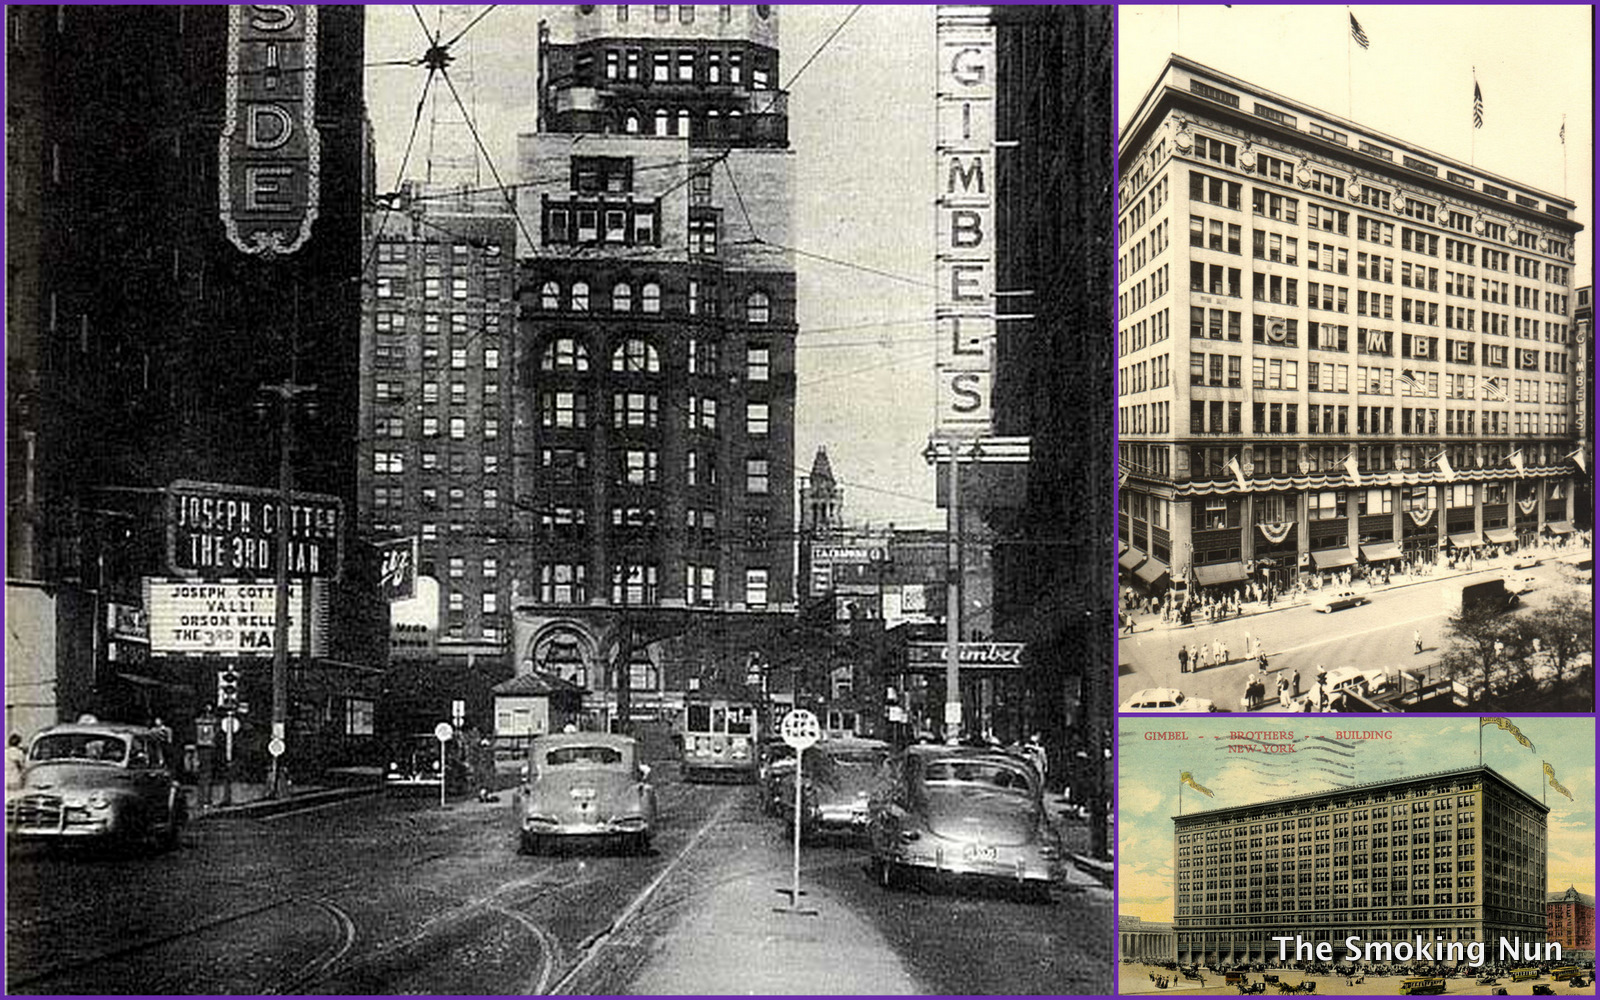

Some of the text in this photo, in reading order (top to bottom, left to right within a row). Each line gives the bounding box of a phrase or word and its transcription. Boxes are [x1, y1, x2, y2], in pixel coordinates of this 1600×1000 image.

[947, 47, 986, 414] GIMBELS
[1265, 317, 1536, 368] GIMBELS
[1575, 332, 1586, 431] GIMBELS
[178, 496, 251, 533] JOSEPH
[190, 533, 319, 573] THE 3RD AN
[171, 587, 294, 599] JOSEPH COTTN
[206, 601, 255, 613] VALLI
[180, 615, 294, 627] ORSON WELLS
[173, 629, 201, 641] THE
[239, 631, 278, 648] MA
[1144, 730, 1393, 741] GIMBEL BROTHERS BUILDING
[1228, 743, 1297, 754] NEW-YORK
